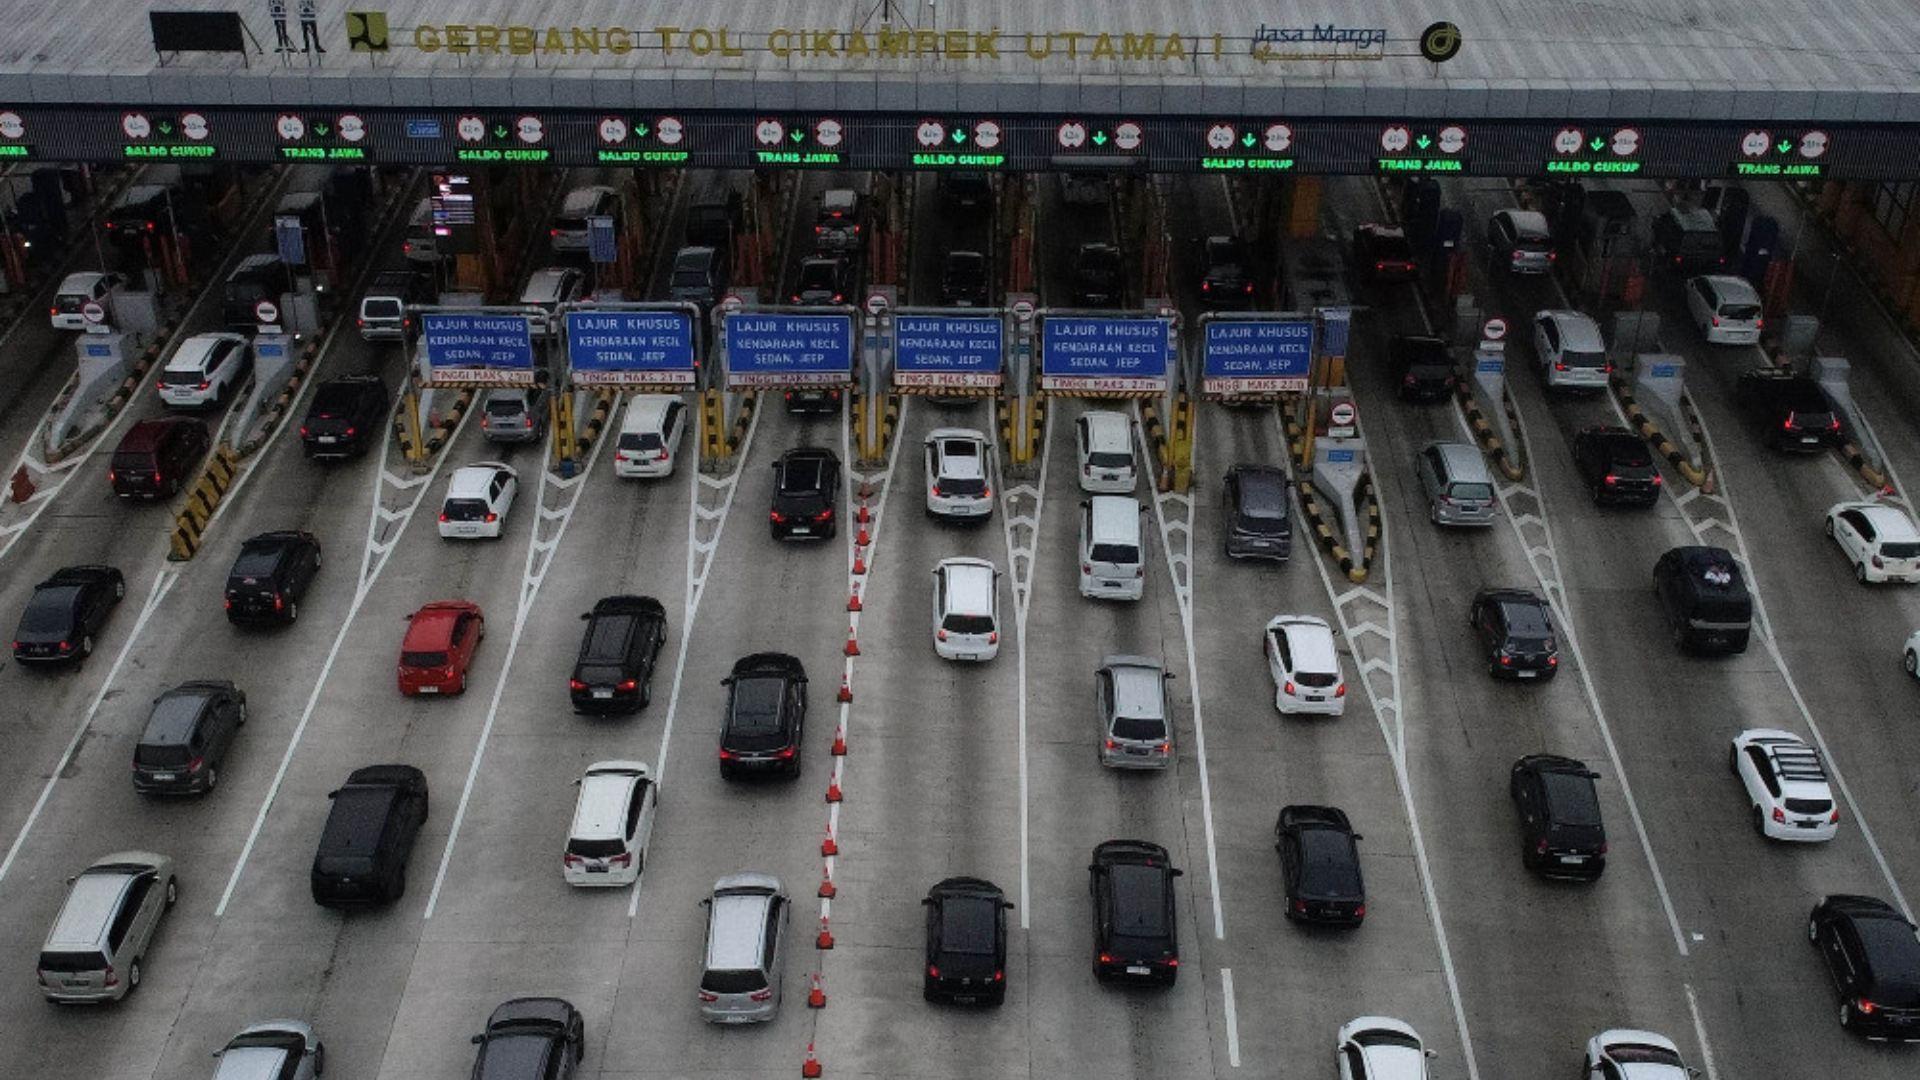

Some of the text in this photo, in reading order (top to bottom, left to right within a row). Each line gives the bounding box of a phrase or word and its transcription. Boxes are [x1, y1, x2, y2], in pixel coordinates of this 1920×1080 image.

[1252, 24, 1386, 48] Jasa Marga
[413, 24, 632, 56] GERBANG
[655, 26, 743, 56] TOL
[768, 27, 999, 60] CIKAMPEK
[1025, 32, 1186, 61] UTAMA
[125, 146, 214, 156] SALDO CUKUP
[284, 148, 363, 158] TRANS JAWA
[459, 150, 548, 160] SALDO CUKUP
[599, 152, 687, 160] SALDO CUKUP
[759, 152, 839, 162] TRANS JAWA
[913, 154, 1004, 165] SALDO CUKUP
[1203, 158, 1292, 168] SALDO CUKUP
[1380, 160, 1461, 170] TRANS JAWA
[1548, 162, 1639, 172] SALDO CUKUP
[1739, 164, 1819, 174] TRANS JAWA
[428, 319, 524, 332] LAJUR KHUSUS
[577, 318, 681, 330] LAJUR KHUSUS
[736, 321, 840, 333] LAJUR KHUSUS
[900, 322, 998, 334] LAJUR KHUSUS
[1055, 325, 1158, 337] LAJUR KHUSUS
[1211, 326, 1309, 339] LAJUR KHUSUS
[429, 335, 527, 348] KENDARAAN KECIL
[579, 336, 680, 347] KENDARAAN KECIL
[736, 339, 840, 349] KENDARAAN KECIL
[900, 338, 997, 350] KENDARAAN KECIL
[1053, 342, 1157, 353] KENDARAAN KECIL
[1209, 344, 1308, 355] KENDARAAN KECIL
[491, 351, 516, 361] JEEP
[641, 351, 665, 361] JEEP
[799, 353, 825, 363] JEEP
[958, 355, 982, 364] JEEP
[1115, 357, 1141, 368] JEEP
[1267, 360, 1292, 370] JEEP
[581, 372, 619, 381] TINGGI
